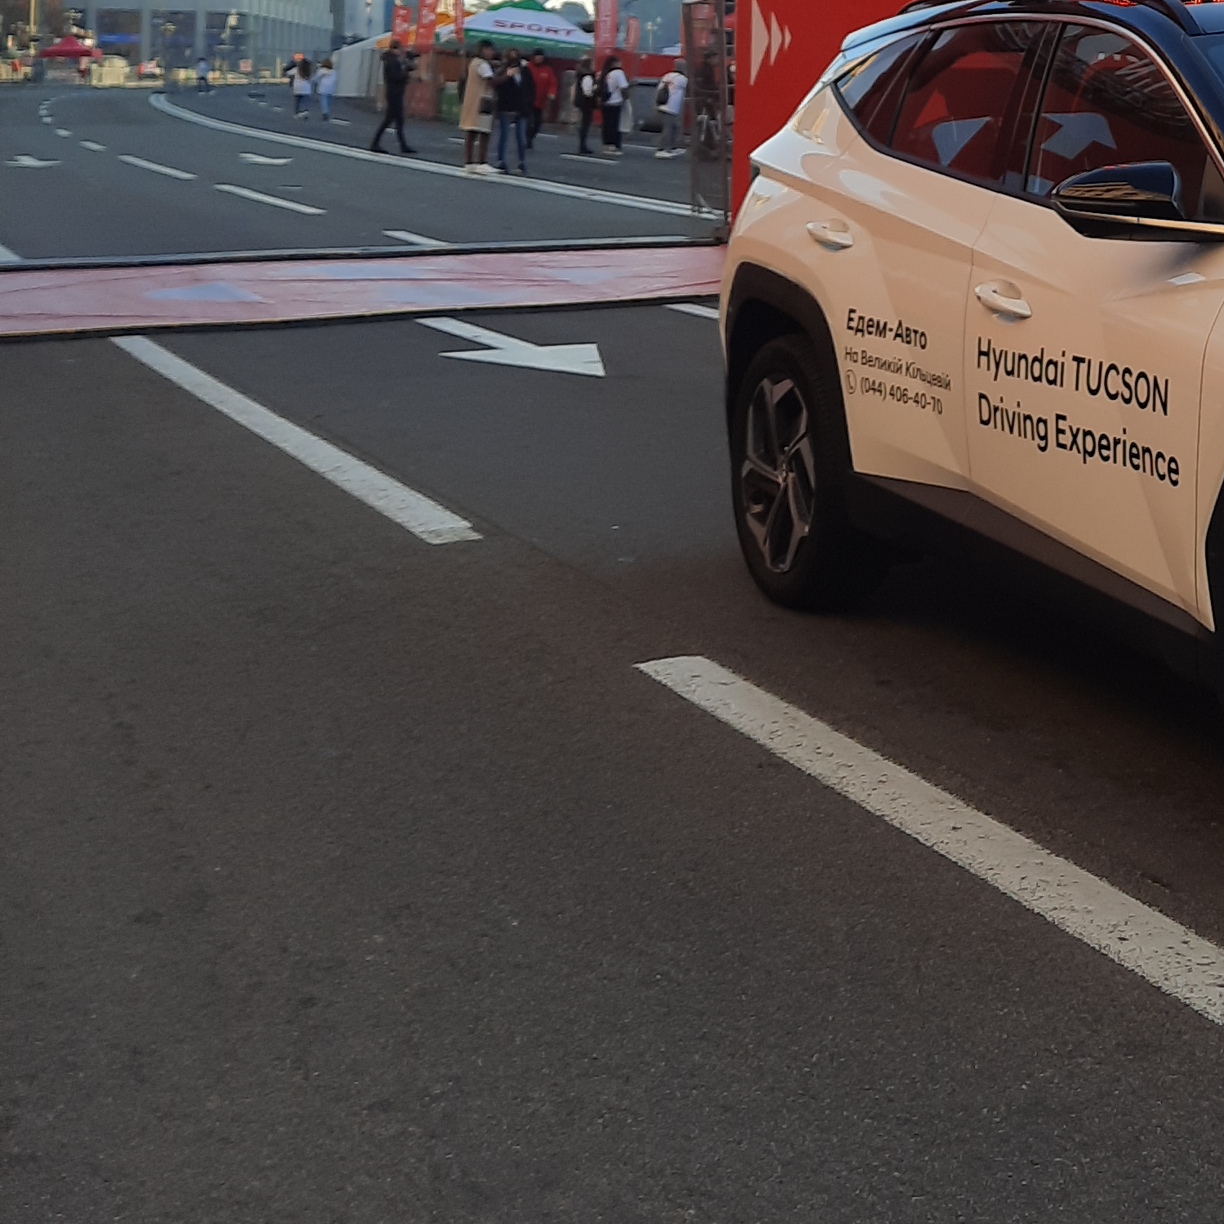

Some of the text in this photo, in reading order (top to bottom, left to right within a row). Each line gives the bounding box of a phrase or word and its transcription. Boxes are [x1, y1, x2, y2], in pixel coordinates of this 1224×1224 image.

[492, 18, 577, 37] SPORT
[846, 307, 928, 350] Едем-Авто
[844, 346, 859, 364] На
[977, 335, 1169, 416] Hyundai TUCSON
[860, 376, 943, 415] (044) 406-40-70
[977, 391, 1180, 487] Driving Experience
